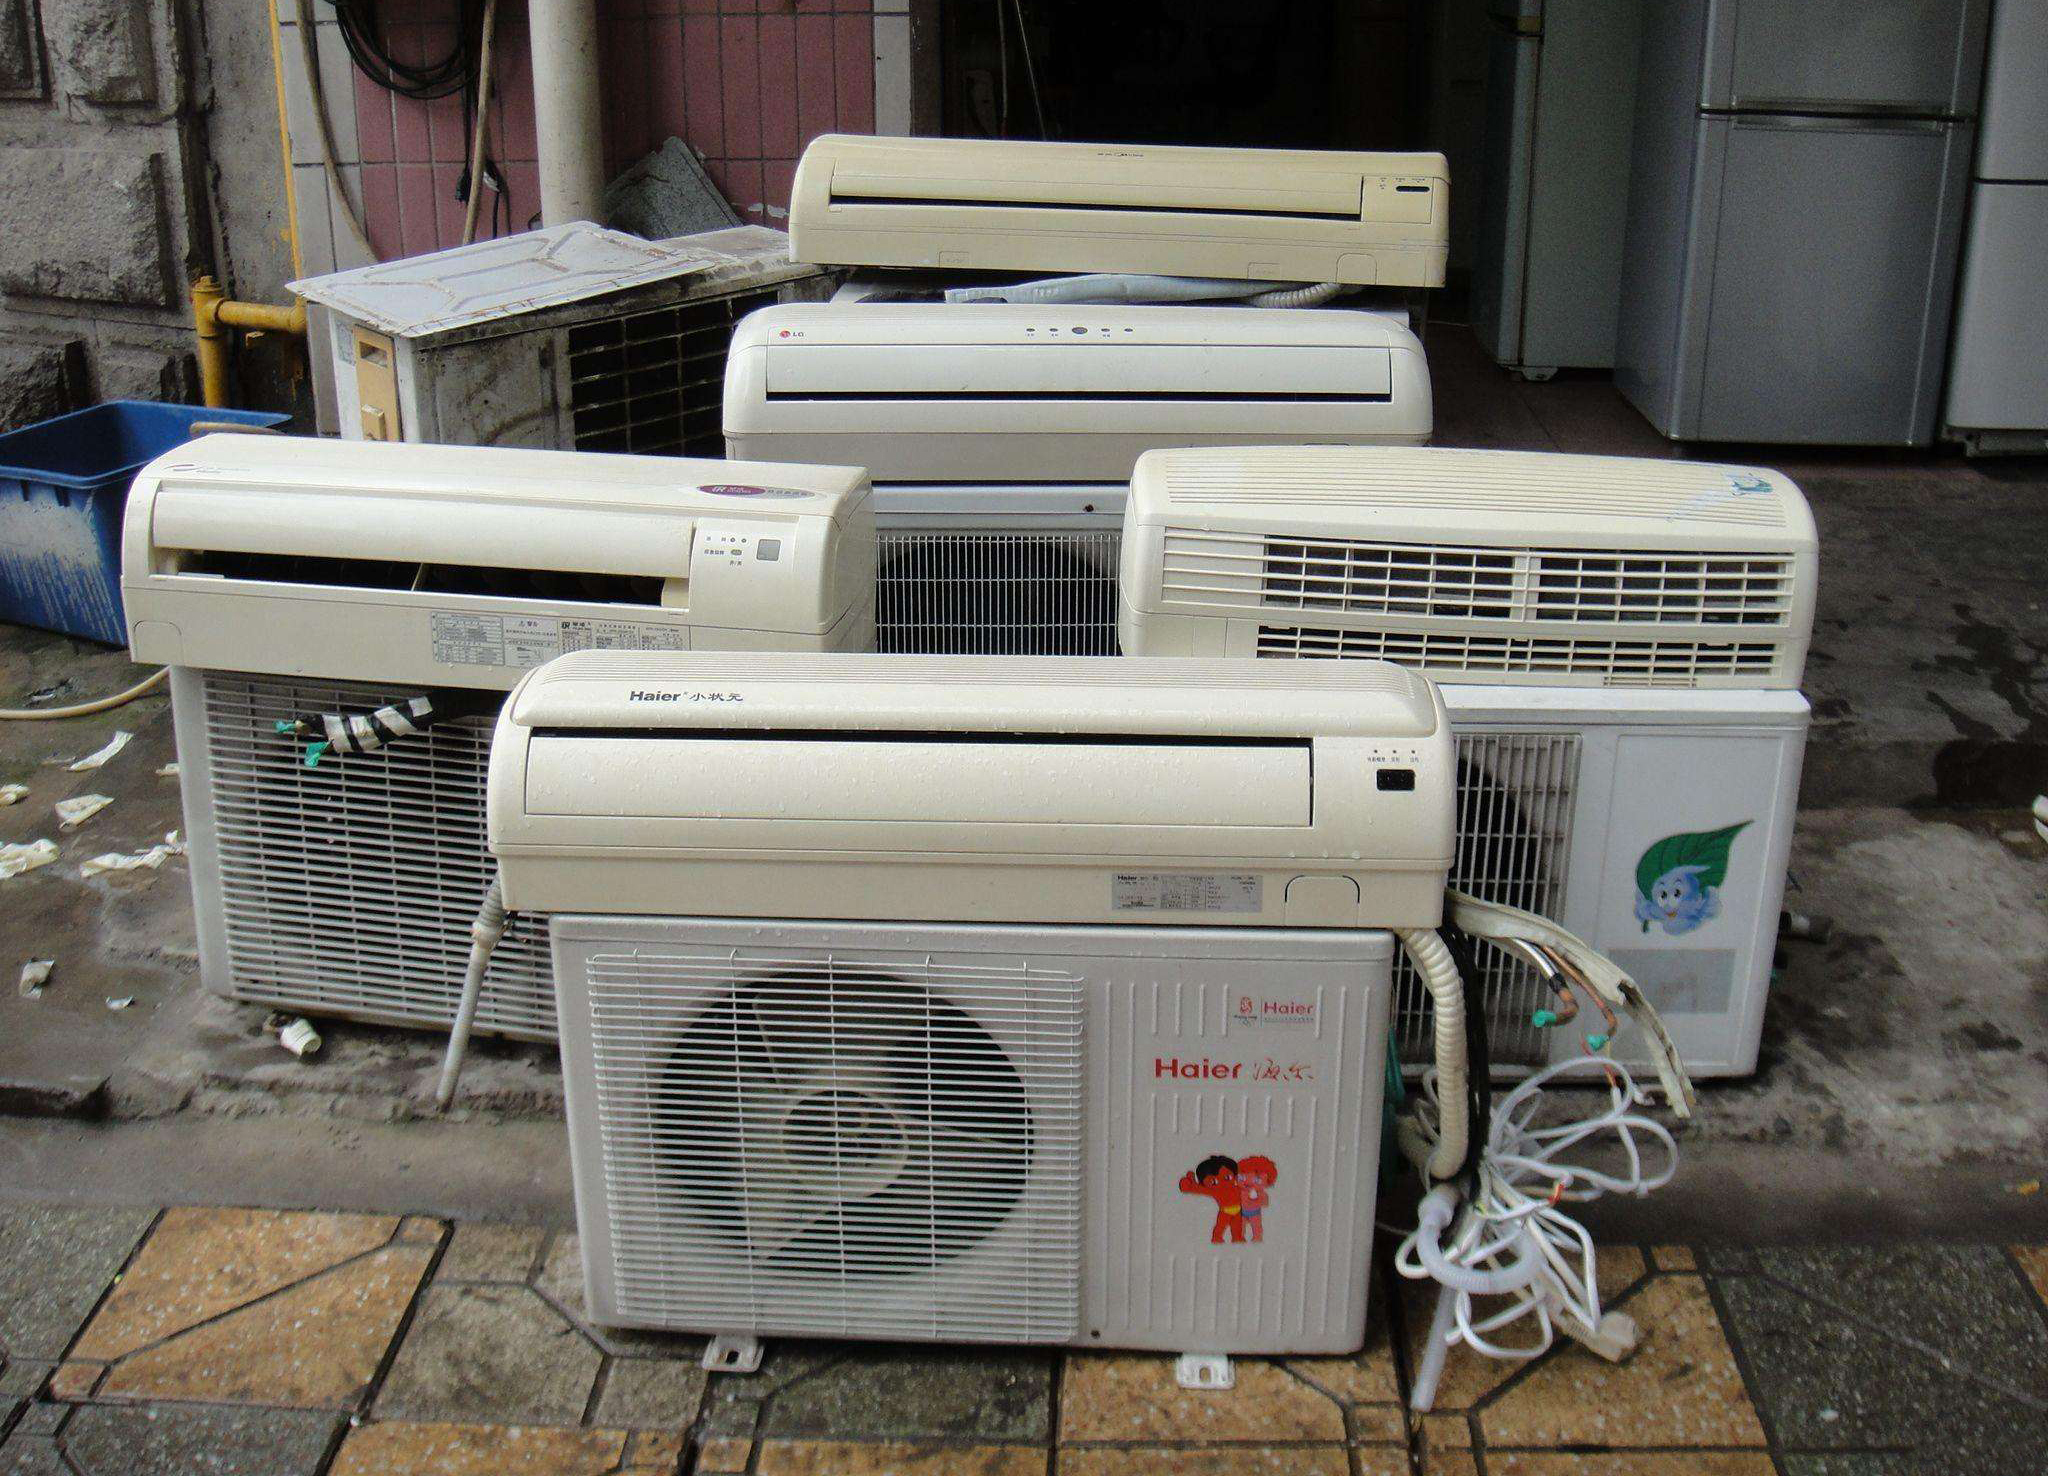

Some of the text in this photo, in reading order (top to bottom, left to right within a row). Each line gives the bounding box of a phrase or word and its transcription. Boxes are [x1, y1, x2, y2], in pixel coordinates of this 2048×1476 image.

[629, 690, 682, 702] Haier
[1263, 1001, 1314, 1014] Haier
[1155, 1058, 1242, 1079] Haier
